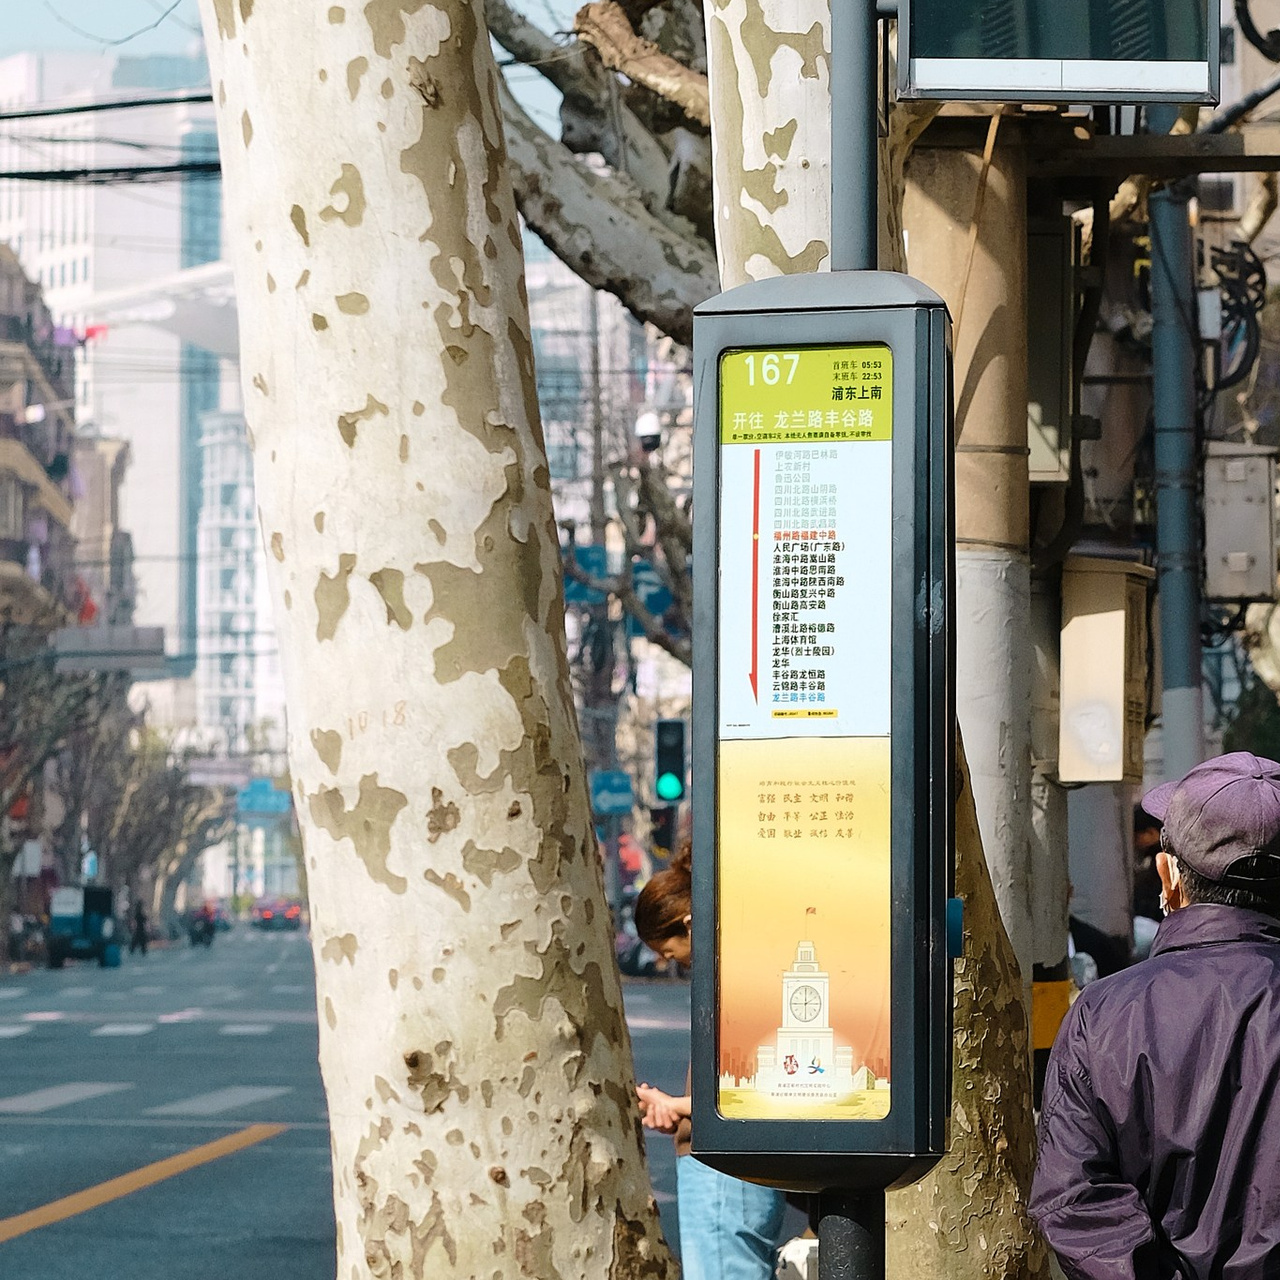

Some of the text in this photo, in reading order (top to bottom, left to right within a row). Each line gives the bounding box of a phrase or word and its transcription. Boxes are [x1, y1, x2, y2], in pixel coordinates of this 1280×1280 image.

[744, 353, 800, 386] 167
[833, 360, 882, 370] 首班车 05:53
[832, 372, 882, 382] 末班车 22:53
[832, 385, 882, 401] 浦东上南
[733, 408, 873, 430] 开往 龙兰路丰谷路
[775, 472, 810, 483] 鲁迅公园
[774, 484, 837, 494] 四川北路山阴路
[774, 530, 836, 540] 福州路福建中路
[773, 541, 845, 552] 人民广场(广东路)
[773, 588, 835, 599] 衡山路复兴中路
[773, 599, 826, 610] 衡山路高安路
[772, 612, 799, 622] 徐家汇
[772, 635, 817, 645] 上海体育馆
[772, 658, 790, 668] 龙华
[772, 692, 825, 702] 龙兰路丰谷路
[783, 793, 802, 803] 民主
[810, 793, 829, 803] 文明
[758, 811, 776, 821] 自由
[809, 811, 828, 821] 公正
